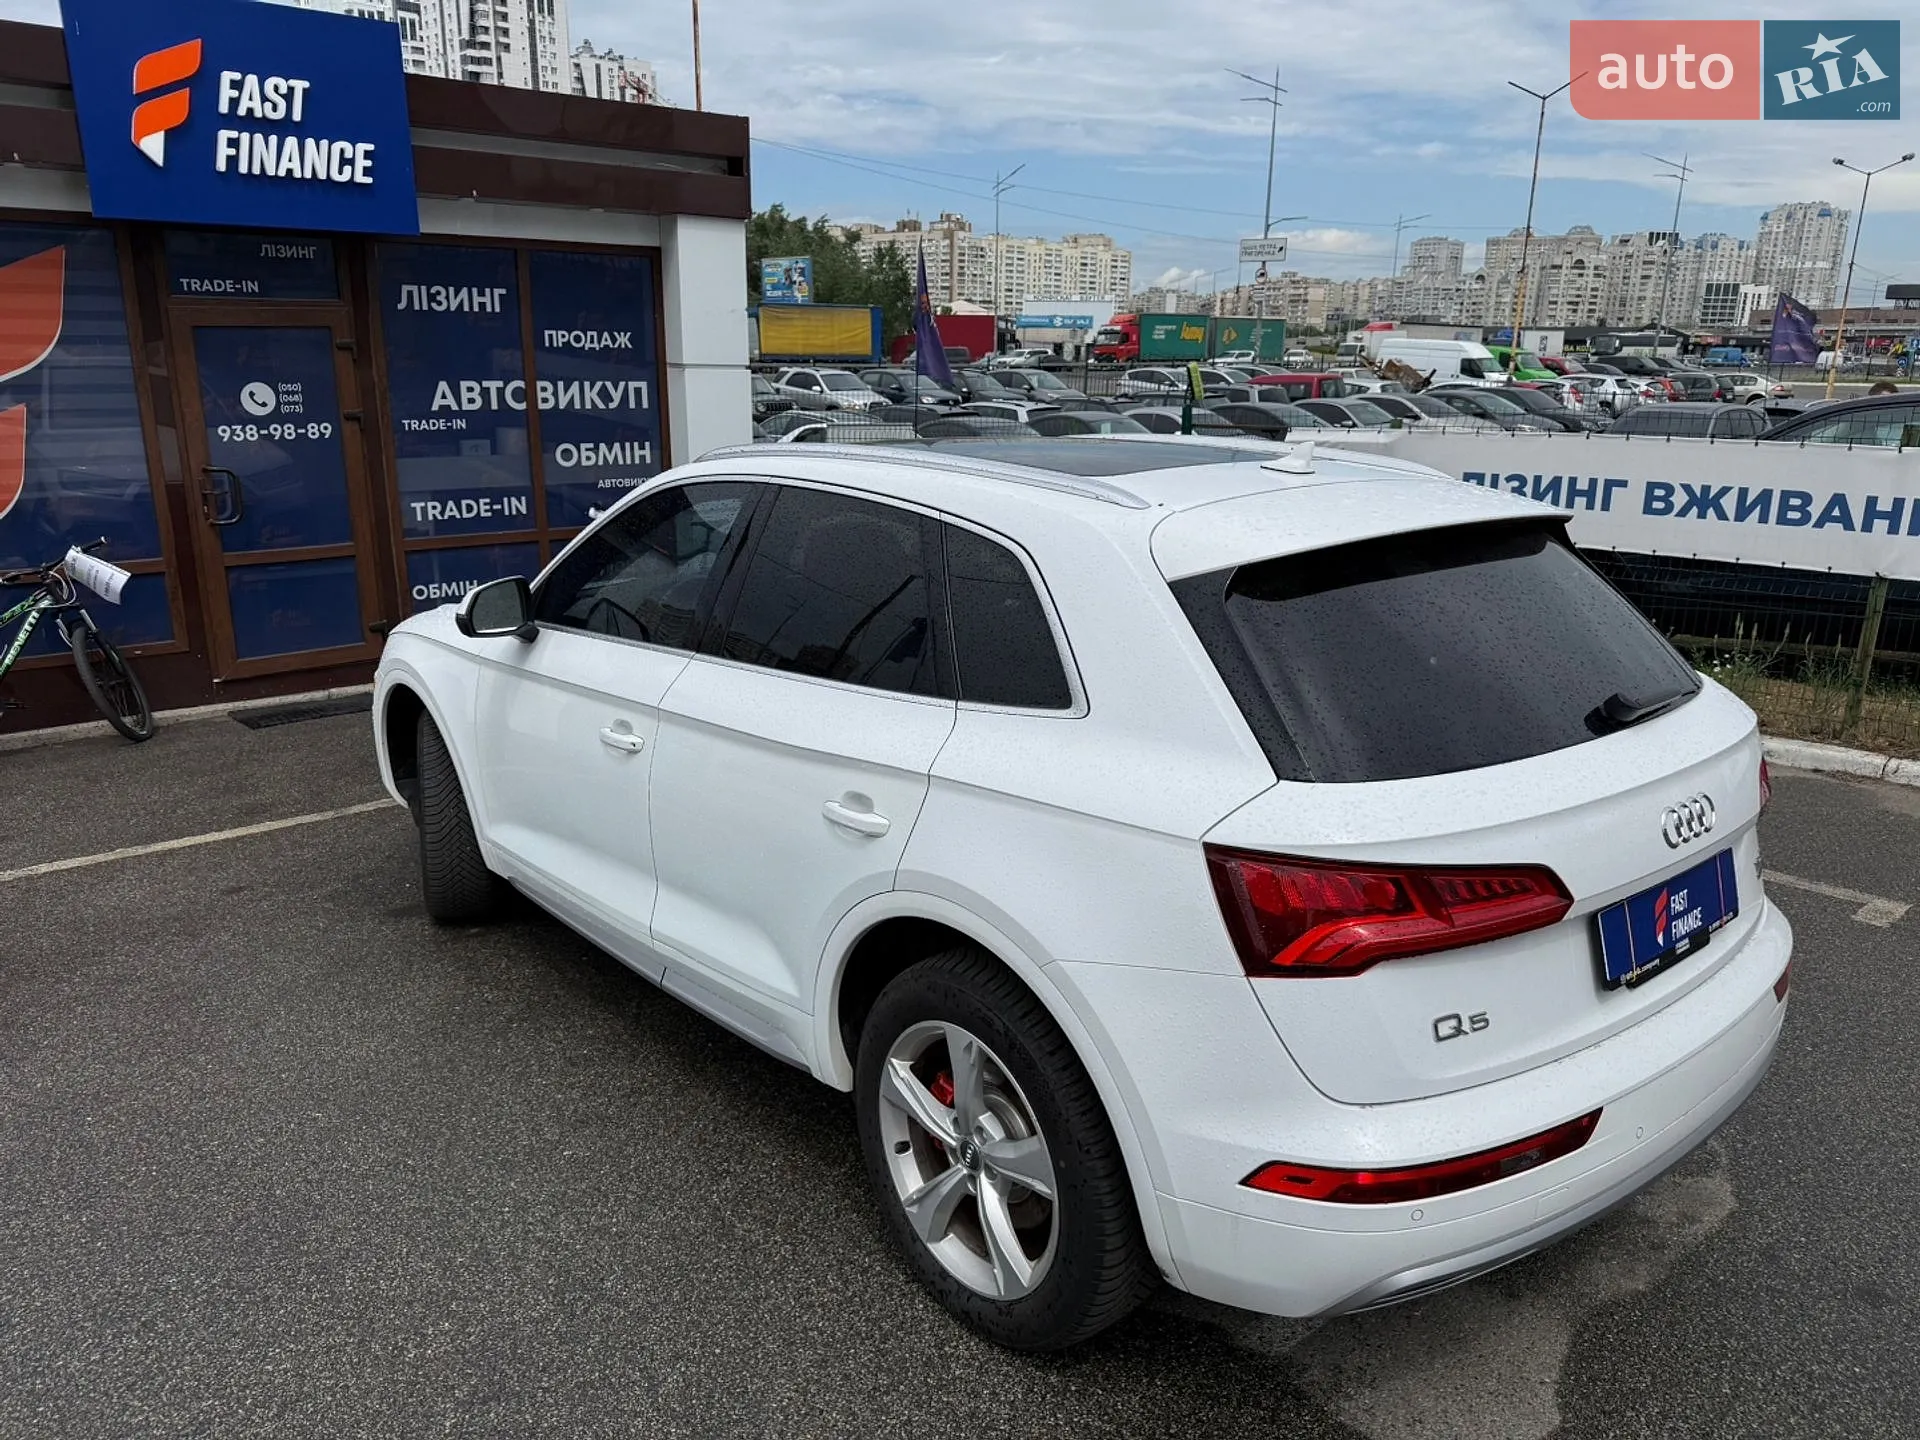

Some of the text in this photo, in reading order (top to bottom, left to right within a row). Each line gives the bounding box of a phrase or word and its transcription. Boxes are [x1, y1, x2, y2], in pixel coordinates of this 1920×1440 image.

[218, 70, 310, 122] FAST
[214, 129, 375, 184] FINANCE
[259, 243, 317, 260] ЛІЗИНГ
[179, 278, 259, 294] TRADE-IN
[397, 284, 507, 313] ЛІЗИНГ
[544, 329, 632, 350] ПРОДАЖ
[280, 404, 303, 414] (073)
[217, 423, 332, 442] 938-98-89
[402, 418, 466, 431] TRADE-IN
[555, 442, 651, 468] ОБМІН
[411, 496, 527, 522] TRADE-IN
[1670, 889, 1688, 916] FAST
[1671, 906, 1703, 941] FINANCE
[1432, 1011, 1490, 1043] Q5
